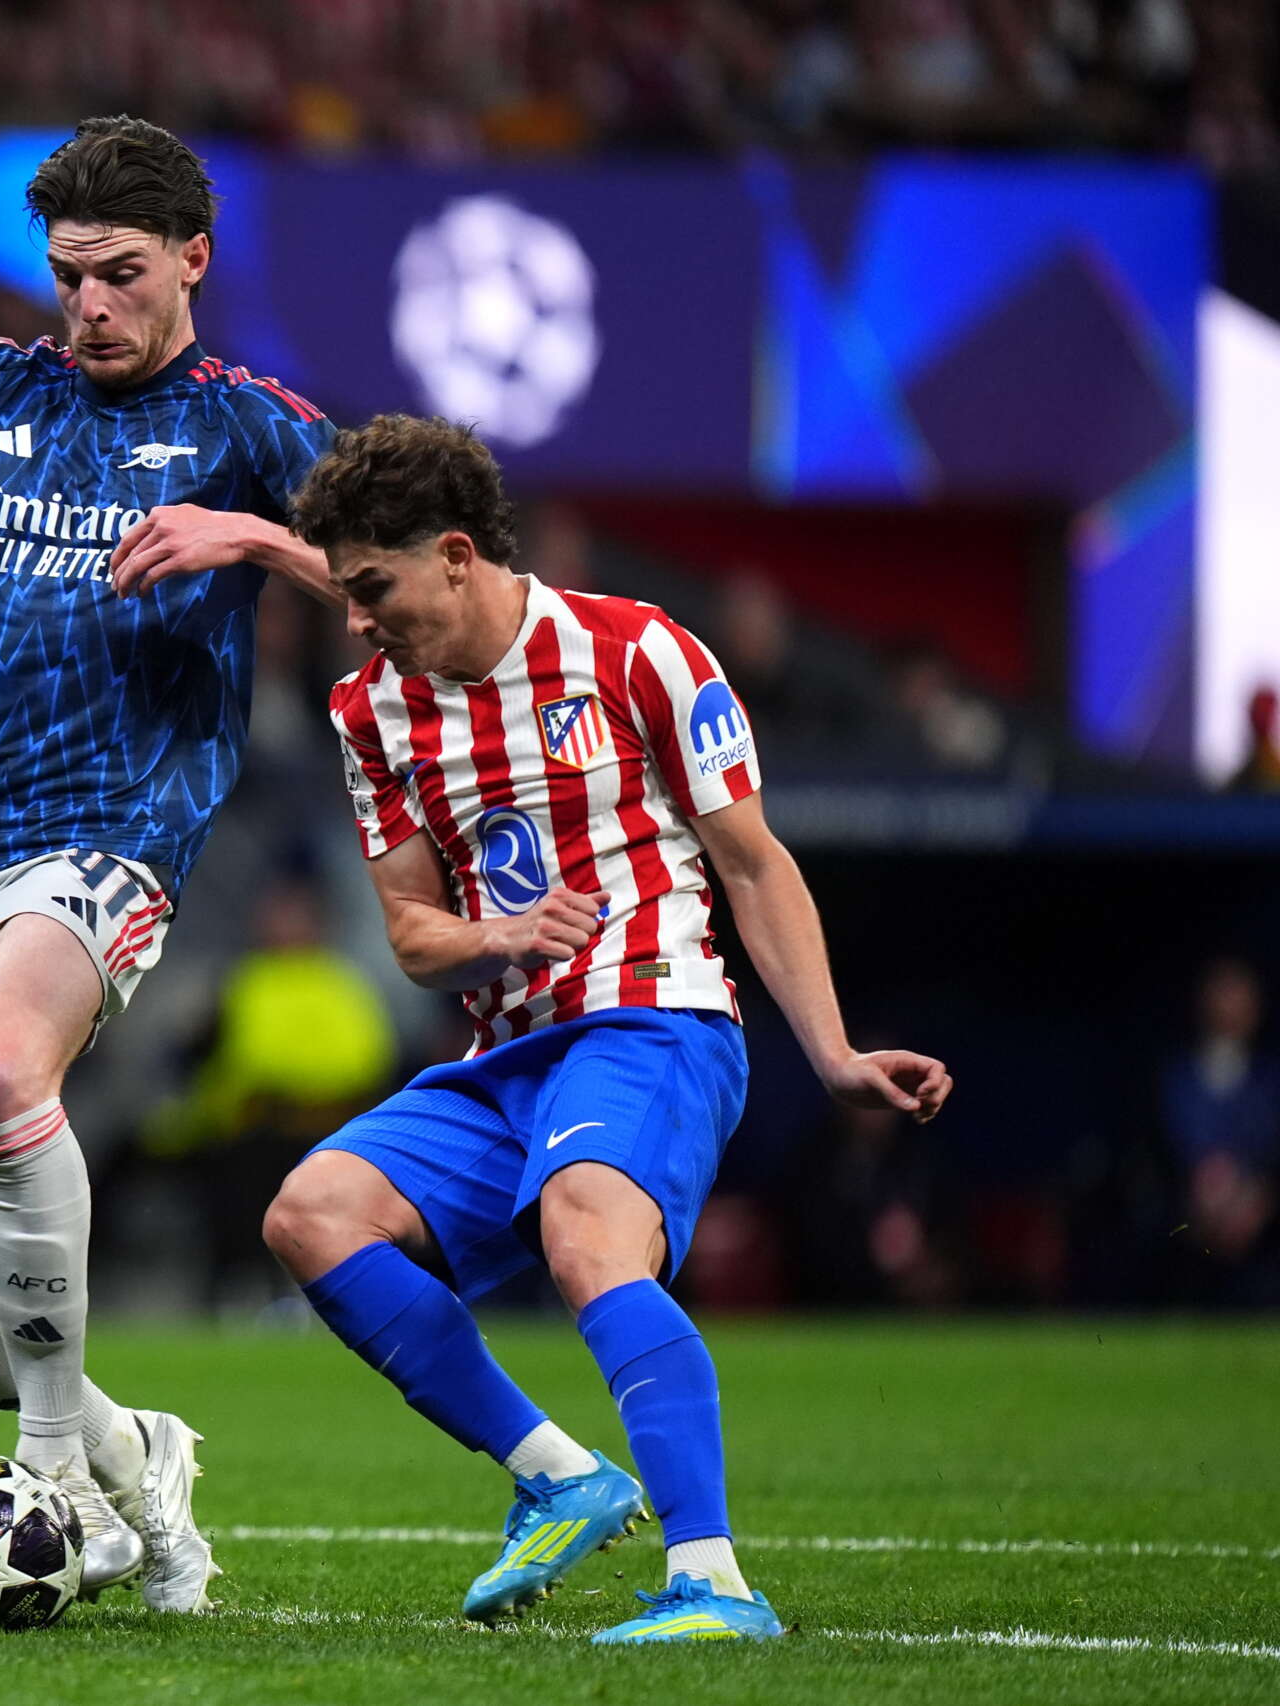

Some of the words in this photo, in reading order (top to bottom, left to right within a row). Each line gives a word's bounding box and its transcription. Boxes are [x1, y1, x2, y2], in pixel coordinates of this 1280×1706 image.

[32, 545, 115, 583] BETTE
[698, 738, 752, 777] kraken
[7, 1272, 67, 1294] AFC
